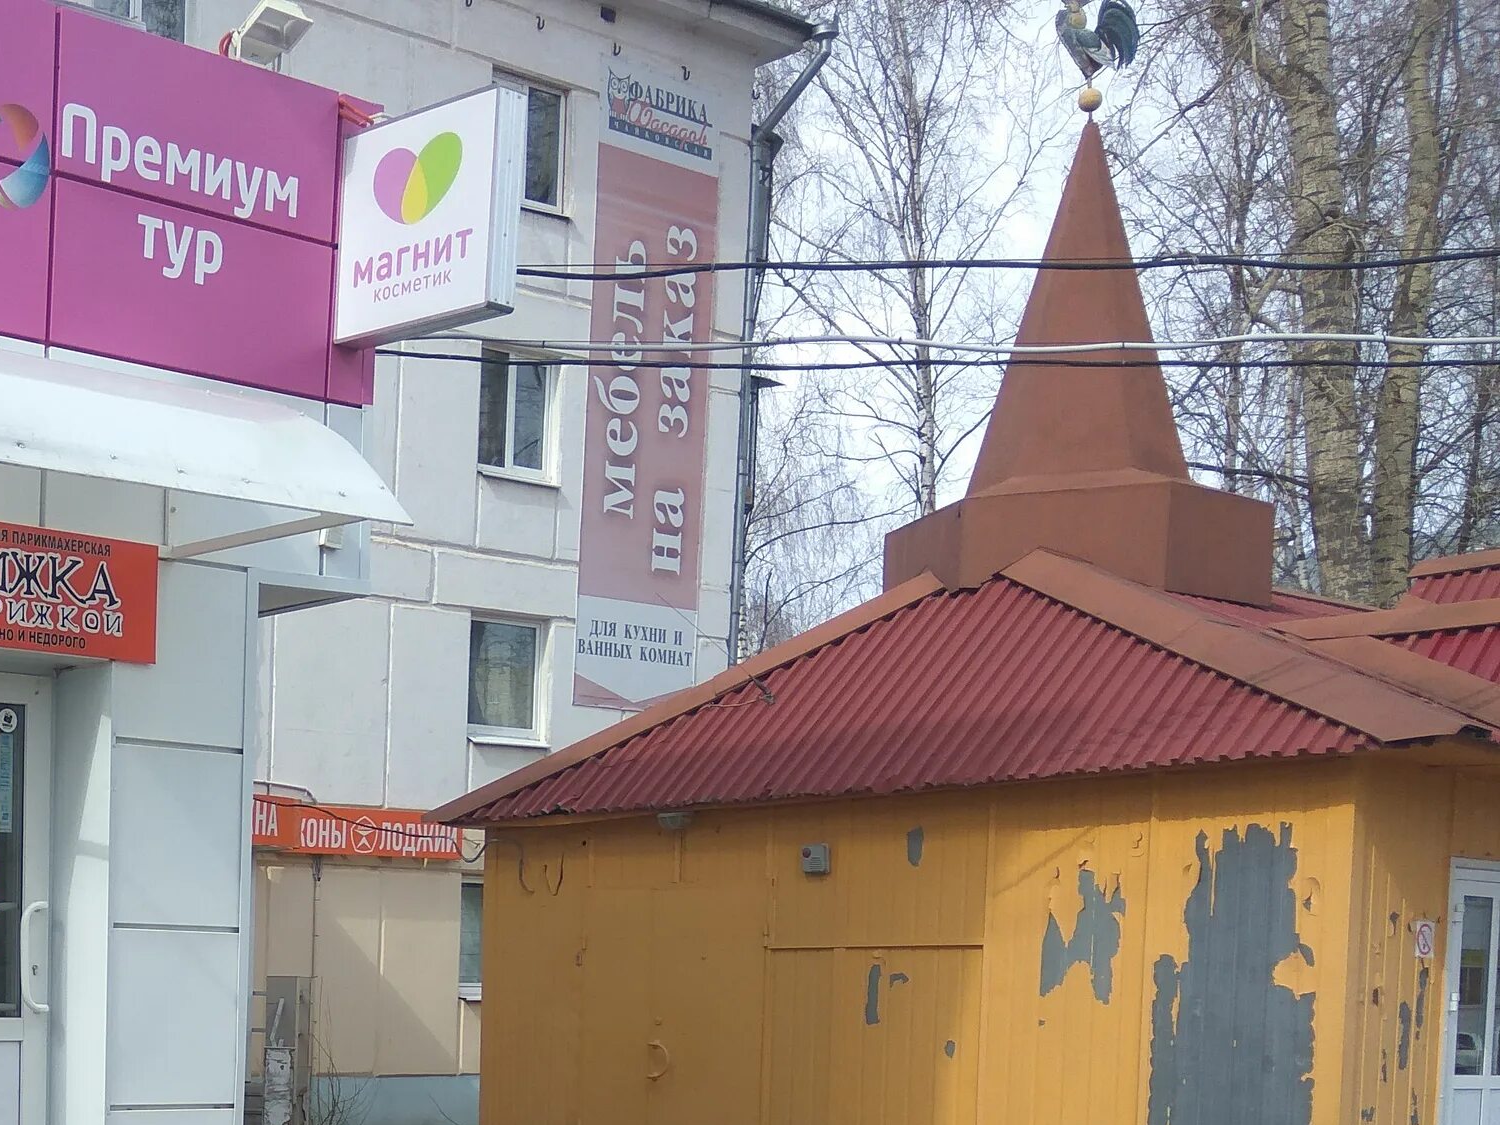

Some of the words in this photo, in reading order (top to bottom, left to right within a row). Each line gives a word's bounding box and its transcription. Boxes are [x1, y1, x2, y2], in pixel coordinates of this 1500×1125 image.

[629, 81, 708, 125] ФАБРИКА
[61, 103, 299, 218] Премиум
[137, 214, 223, 285] тур
[353, 228, 473, 288] магнит
[373, 269, 452, 303] косметик
[658, 225, 699, 439] заказ
[11, 530, 111, 558] ПАРИКМАХЕРСКАЯ
[651, 487, 685, 576] на
[18, 629, 25, 642] И
[29, 631, 86, 650] НЕДОРОГО
[577, 638, 633, 660] ВАННЫХ
[640, 646, 692, 667] КОМНАТ
[589, 619, 617, 638] ДЛЯ
[624, 623, 667, 644] КУХНИ
[674, 630, 683, 646] И
[379, 821, 458, 857] ЛОДЖИИ
